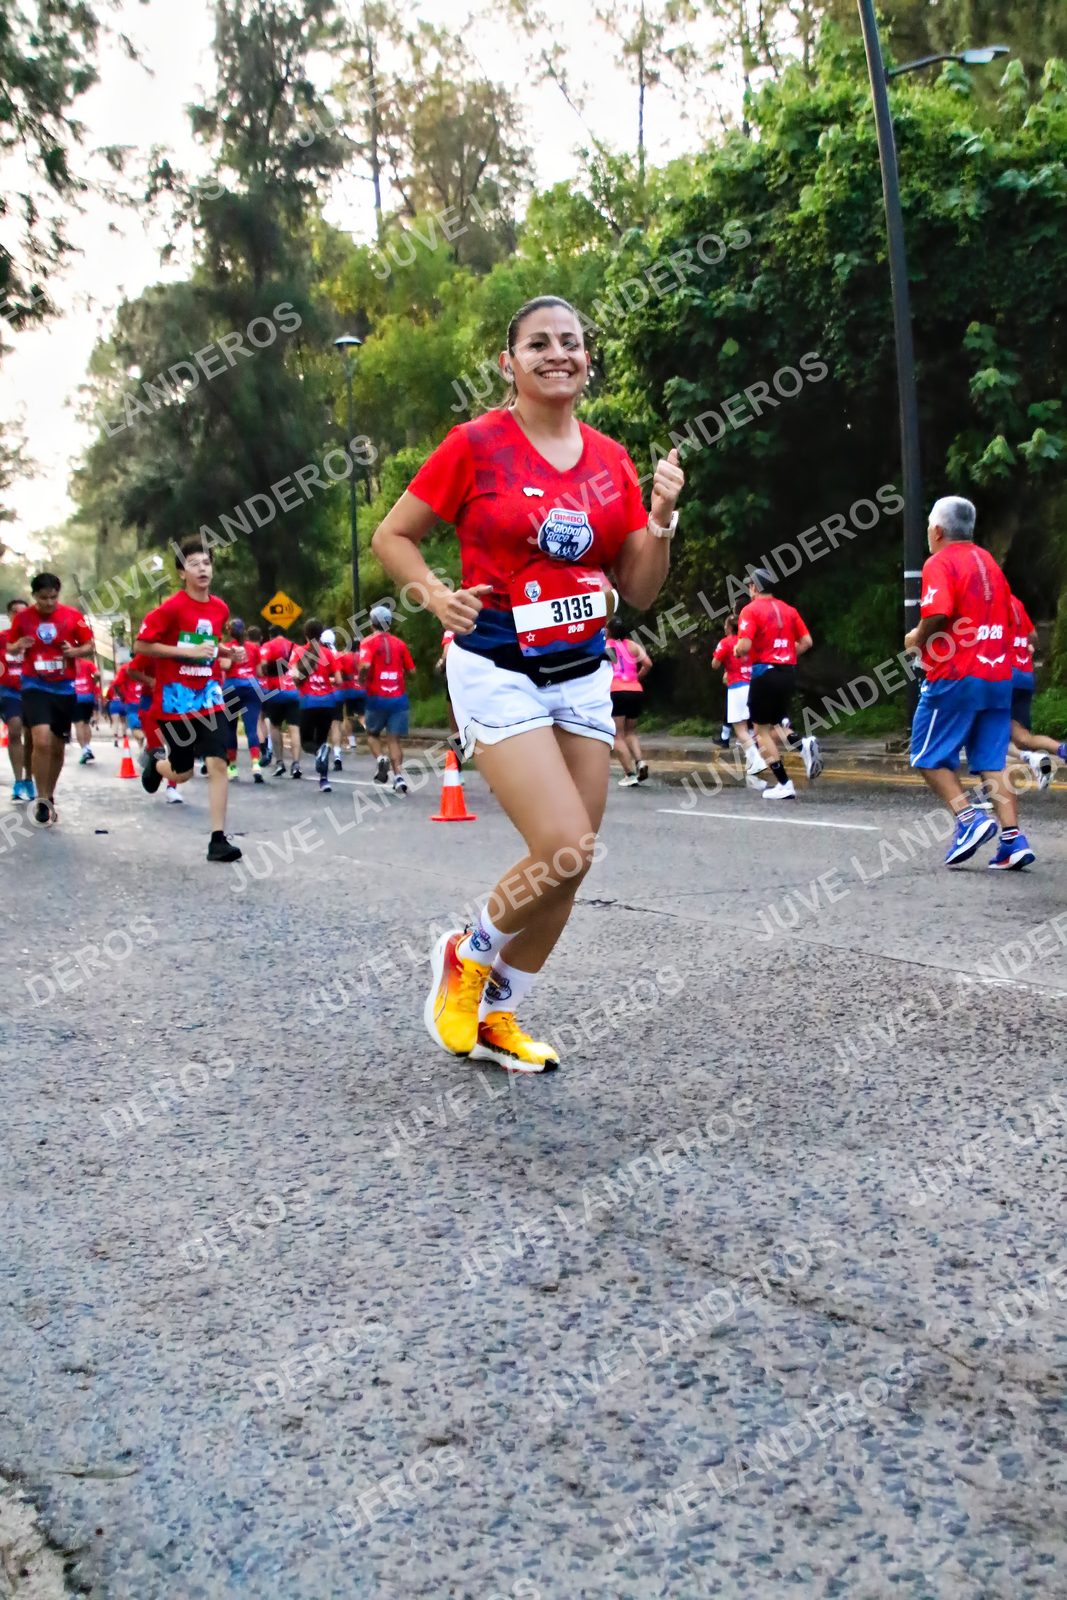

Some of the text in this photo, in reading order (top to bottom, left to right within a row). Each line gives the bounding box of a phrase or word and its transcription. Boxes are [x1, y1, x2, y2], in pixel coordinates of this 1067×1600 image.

[554, 513, 582, 523] BIMBO
[553, 523, 582, 537] Global
[546, 531, 570, 542] Race
[551, 595, 593, 623] 3135
